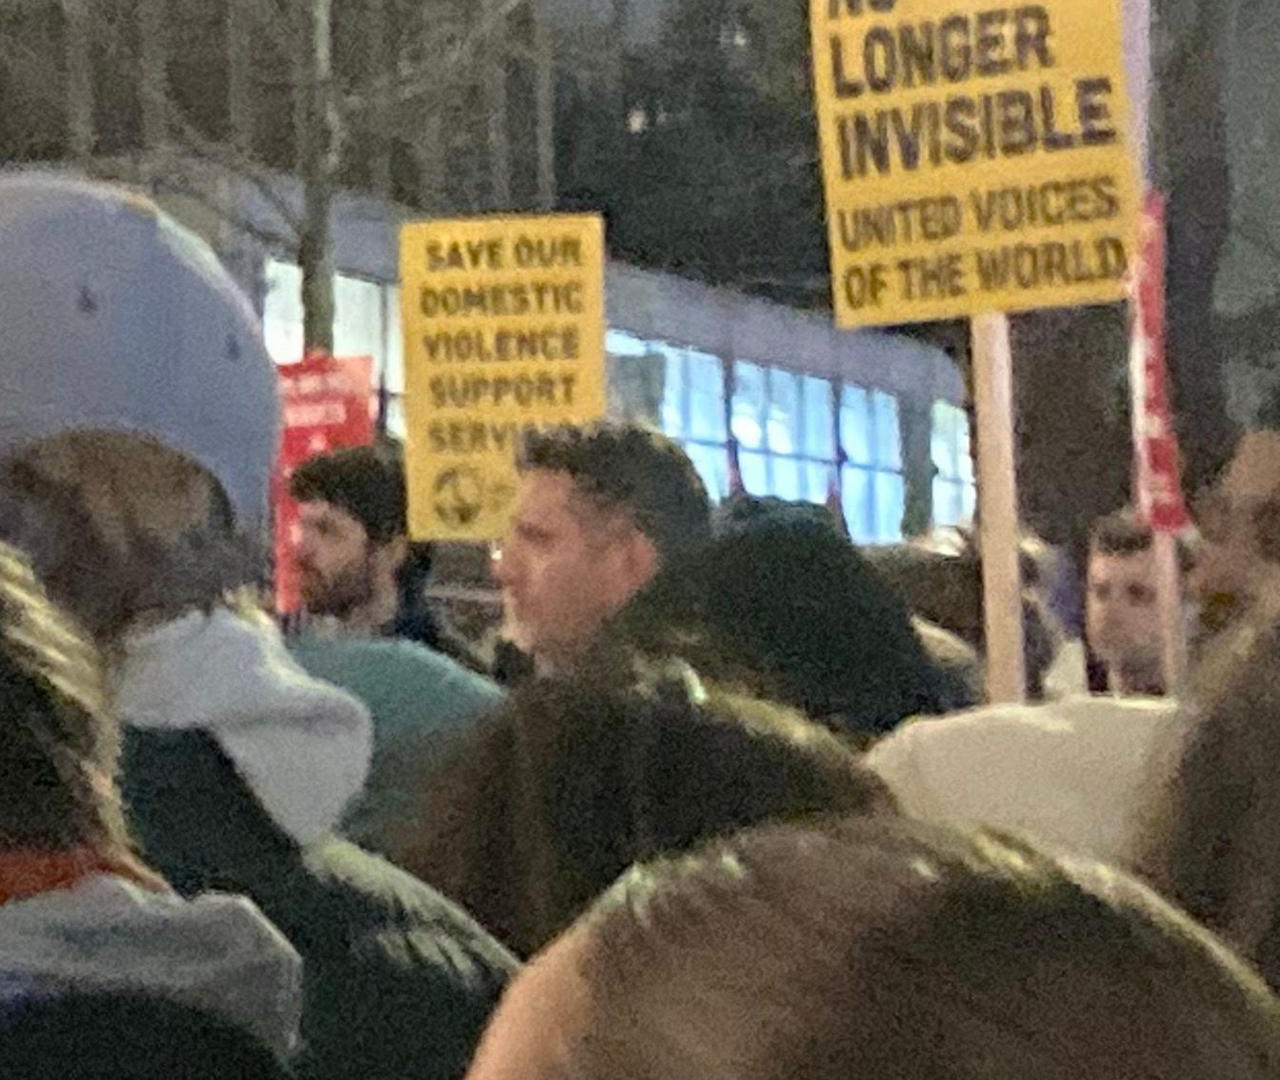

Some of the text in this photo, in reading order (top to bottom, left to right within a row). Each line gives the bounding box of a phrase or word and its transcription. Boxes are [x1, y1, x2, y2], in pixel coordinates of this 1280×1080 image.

[830, 5, 1053, 98] LONGER
[838, 77, 1116, 181] INVISIBLE
[838, 175, 1120, 252] UNITED VOICES
[426, 236, 581, 271] SAVE OUR
[845, 236, 1130, 309] OF THE WORLD
[420, 281, 584, 318] DOMESTIC
[423, 327, 580, 361] VIOLENCE
[429, 373, 575, 408] SUPPORT
